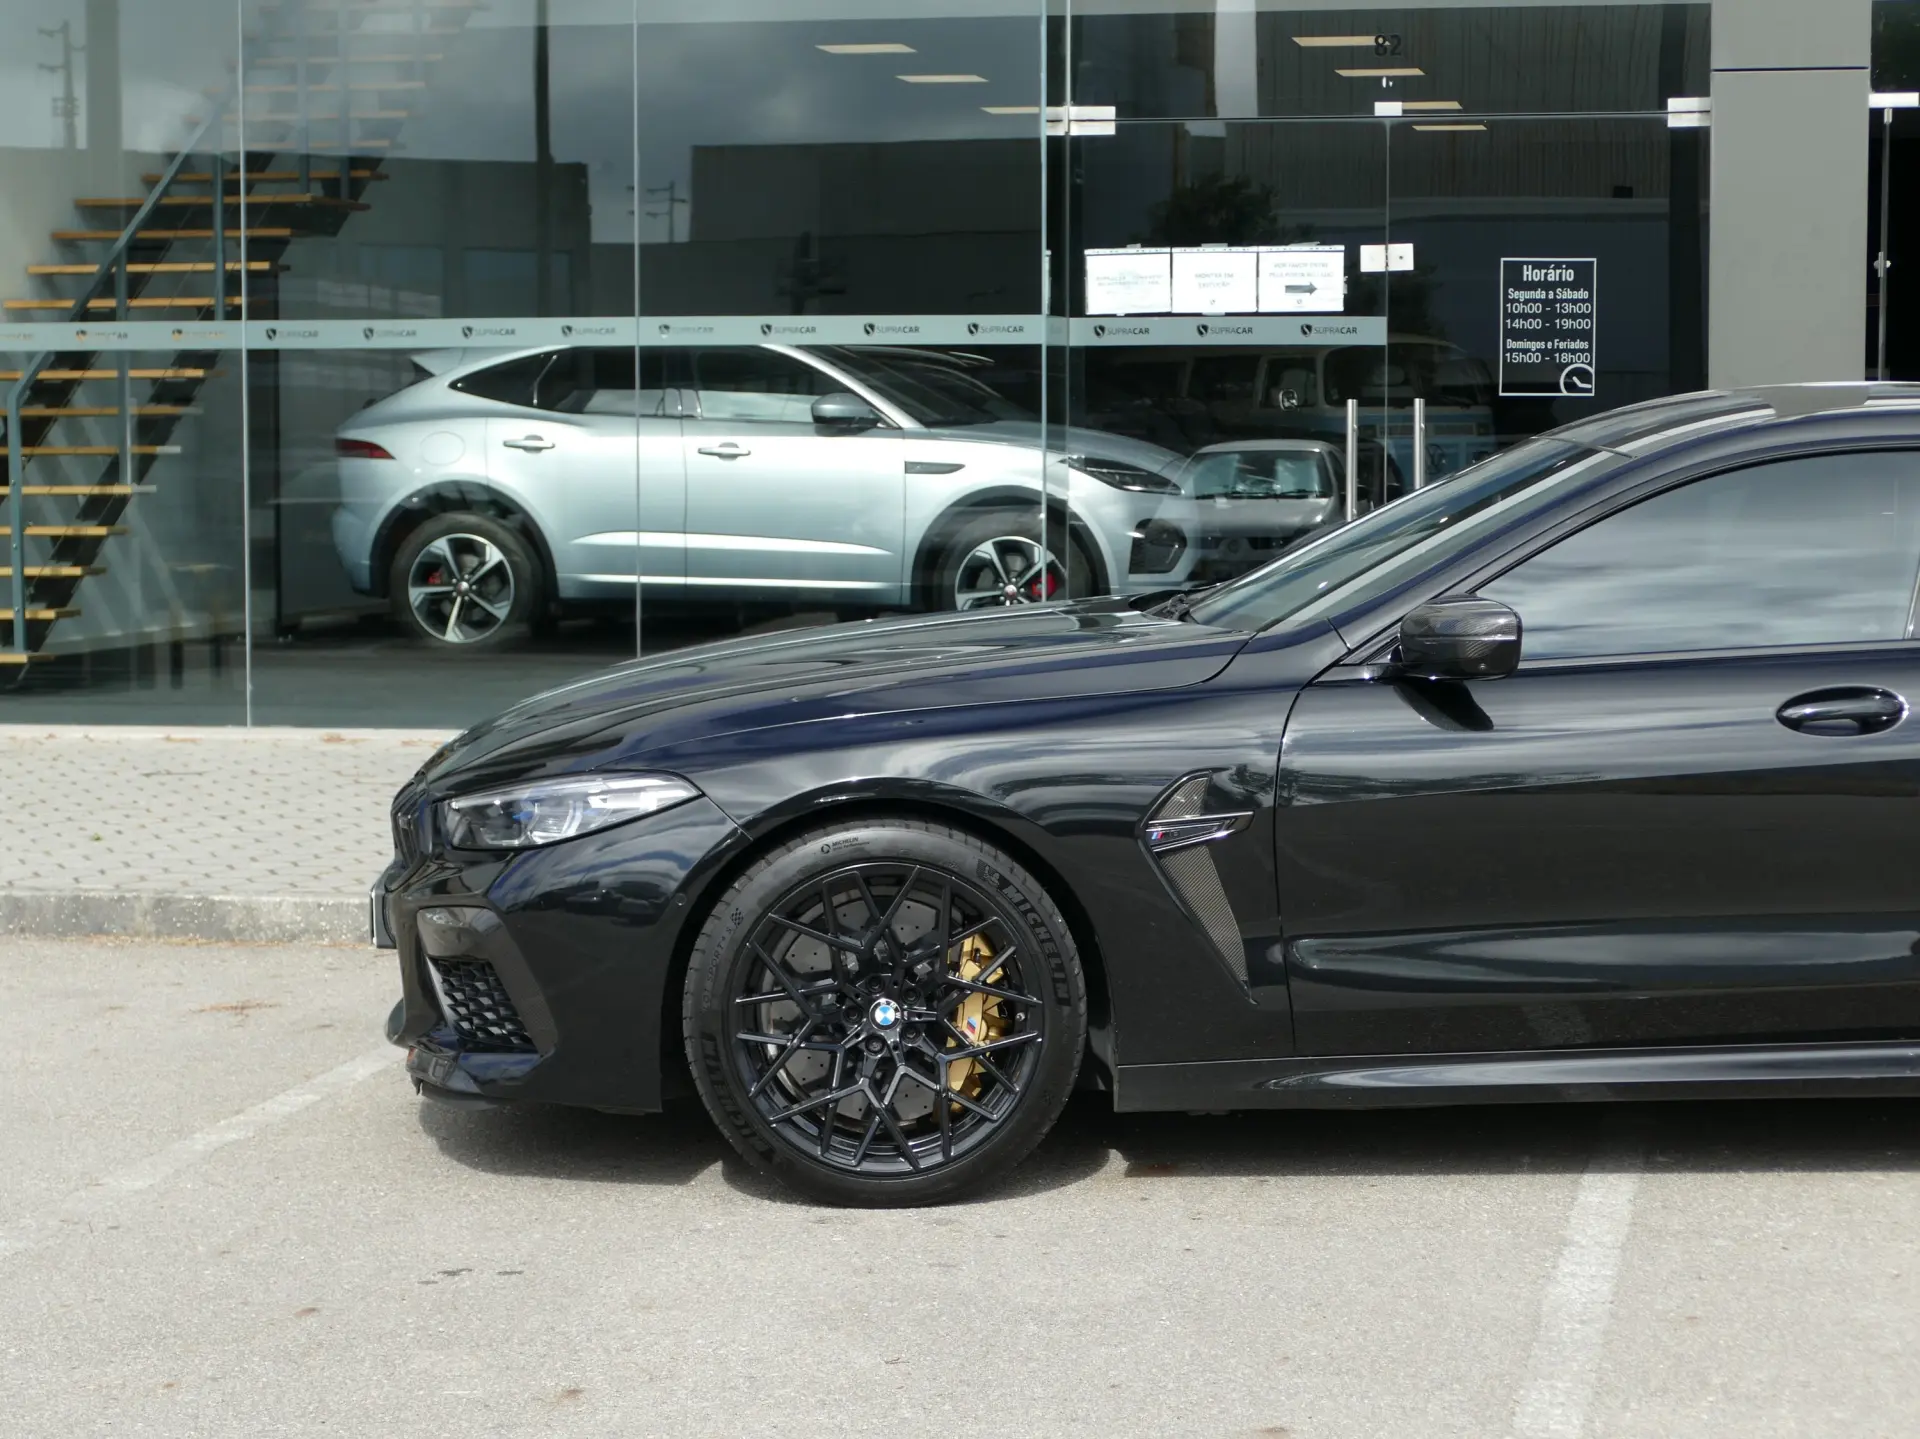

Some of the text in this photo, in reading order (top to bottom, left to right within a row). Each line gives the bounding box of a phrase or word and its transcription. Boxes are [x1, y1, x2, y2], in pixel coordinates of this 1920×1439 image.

[1374, 34, 1402, 56] 82
[1522, 264, 1575, 282] Horário
[1508, 287, 1589, 302] Segunda a Sábado
[1506, 302, 1542, 314] 10h00
[1555, 302, 1591, 314] 13h00
[774, 325, 817, 335] SUPRACAR
[876, 325, 920, 334] SUPRACAR
[980, 325, 1025, 334] SUPRACAR
[1505, 318, 1542, 330] 14h00
[1555, 318, 1591, 330] 19h00
[474, 327, 516, 337] SUPRACAR
[1107, 326, 1150, 336] SUPRACAR
[1209, 326, 1253, 335] SUPRACAR
[1314, 326, 1358, 335] SUPRACAR
[1506, 339, 1589, 351] Domingos e Feriados
[1505, 352, 1541, 363] 15h00
[1554, 352, 1591, 363] 18h00
[1002, 884, 1070, 1000] MICHELIN
[707, 942, 725, 983] SPORT
[701, 1040, 771, 1152] MICHELIN
